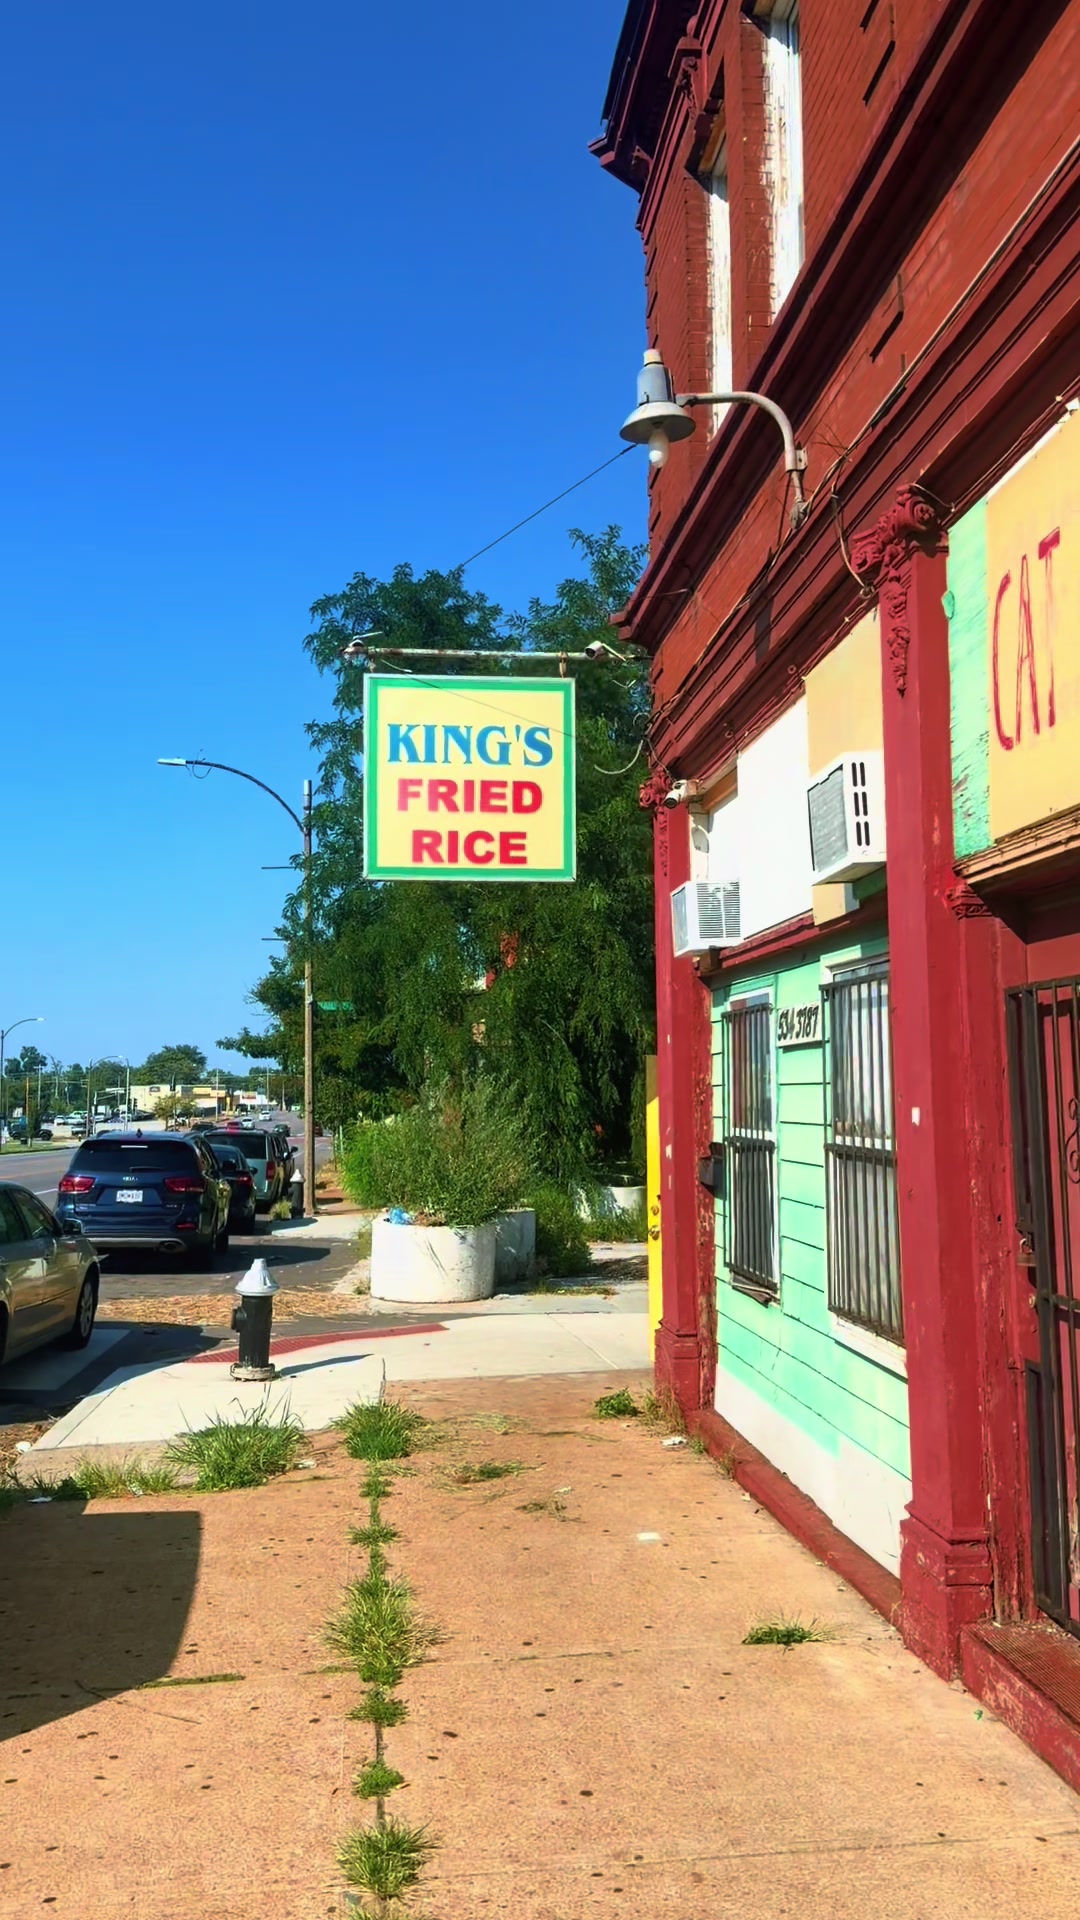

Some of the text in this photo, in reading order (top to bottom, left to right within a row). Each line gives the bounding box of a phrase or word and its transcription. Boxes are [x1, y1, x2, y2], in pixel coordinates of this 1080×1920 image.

[387, 723, 553, 767] KING'S
[397, 778, 543, 814] FRIED
[411, 829, 528, 865] RICE
